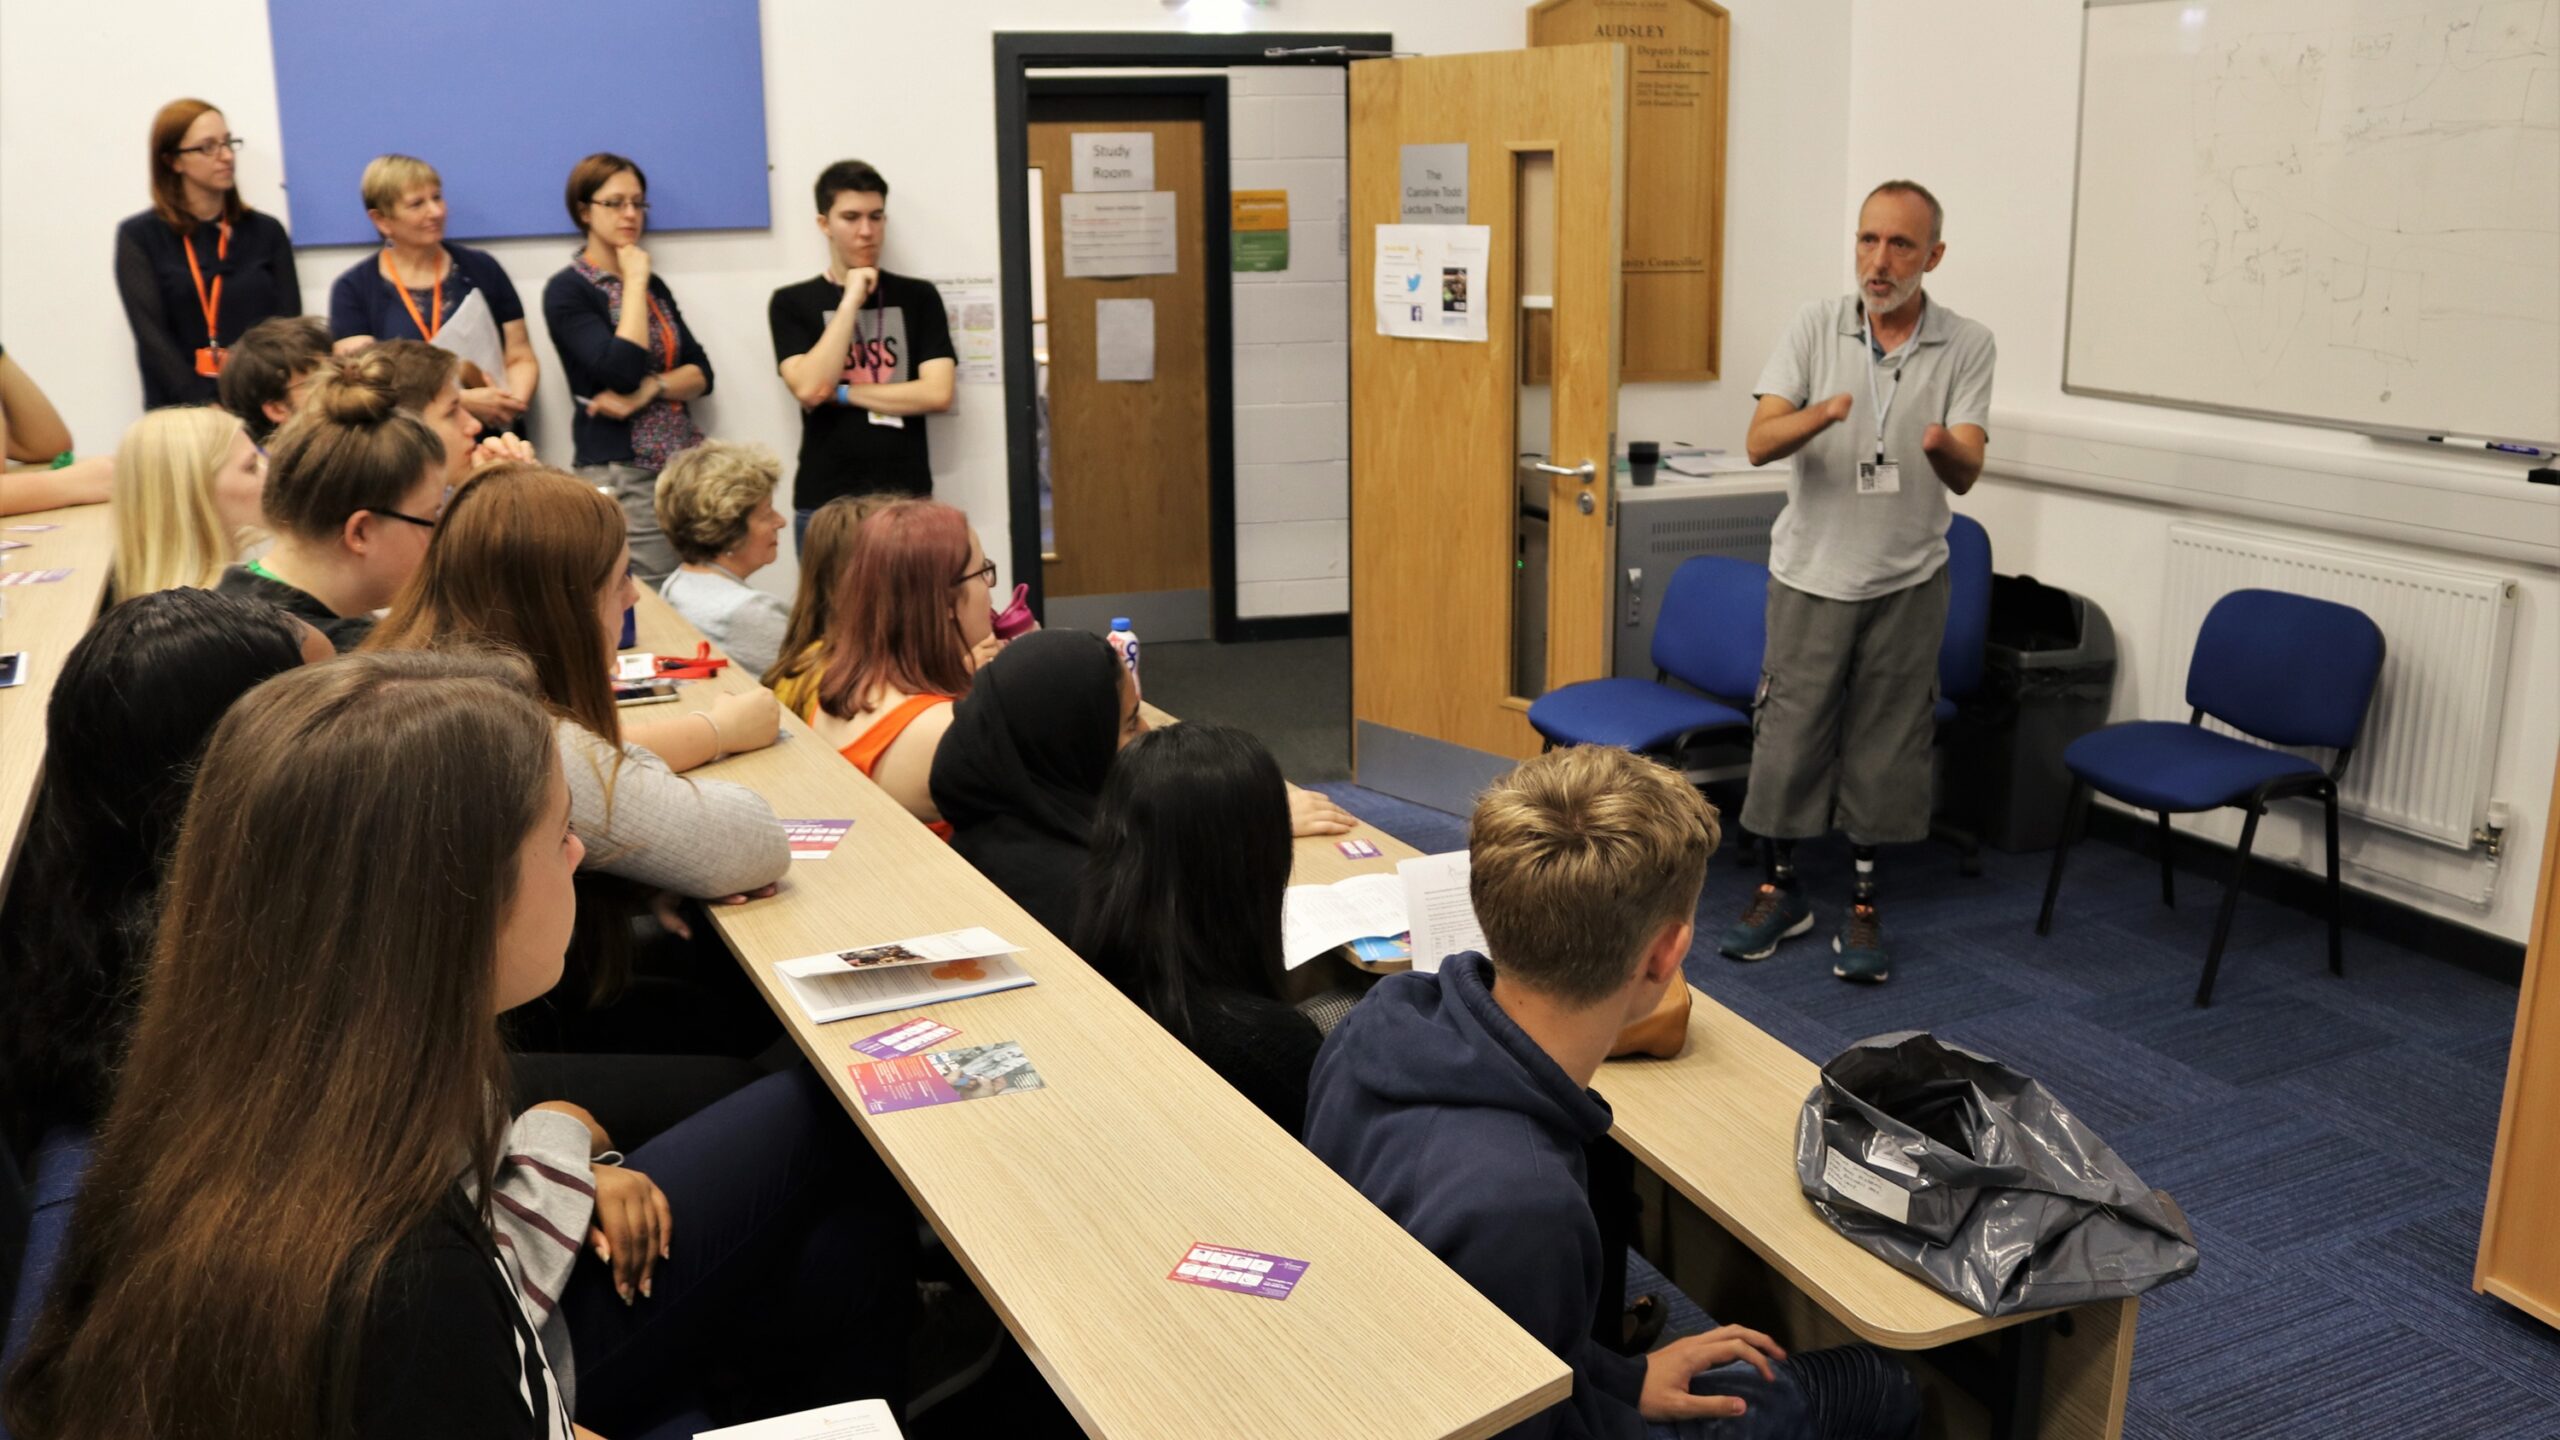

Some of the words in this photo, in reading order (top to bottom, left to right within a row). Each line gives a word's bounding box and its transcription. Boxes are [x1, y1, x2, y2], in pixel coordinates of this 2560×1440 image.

[1594, 24, 1665, 38] AUDSLEY
[1093, 145, 1131, 159] Study
[1093, 167, 1132, 179] Room
[1425, 169, 1442, 181] The
[1406, 186, 1440, 198] Caroline
[1442, 186, 1462, 198] Todd
[1402, 204, 1433, 215] Lecture
[1435, 203, 1465, 215] Theatre
